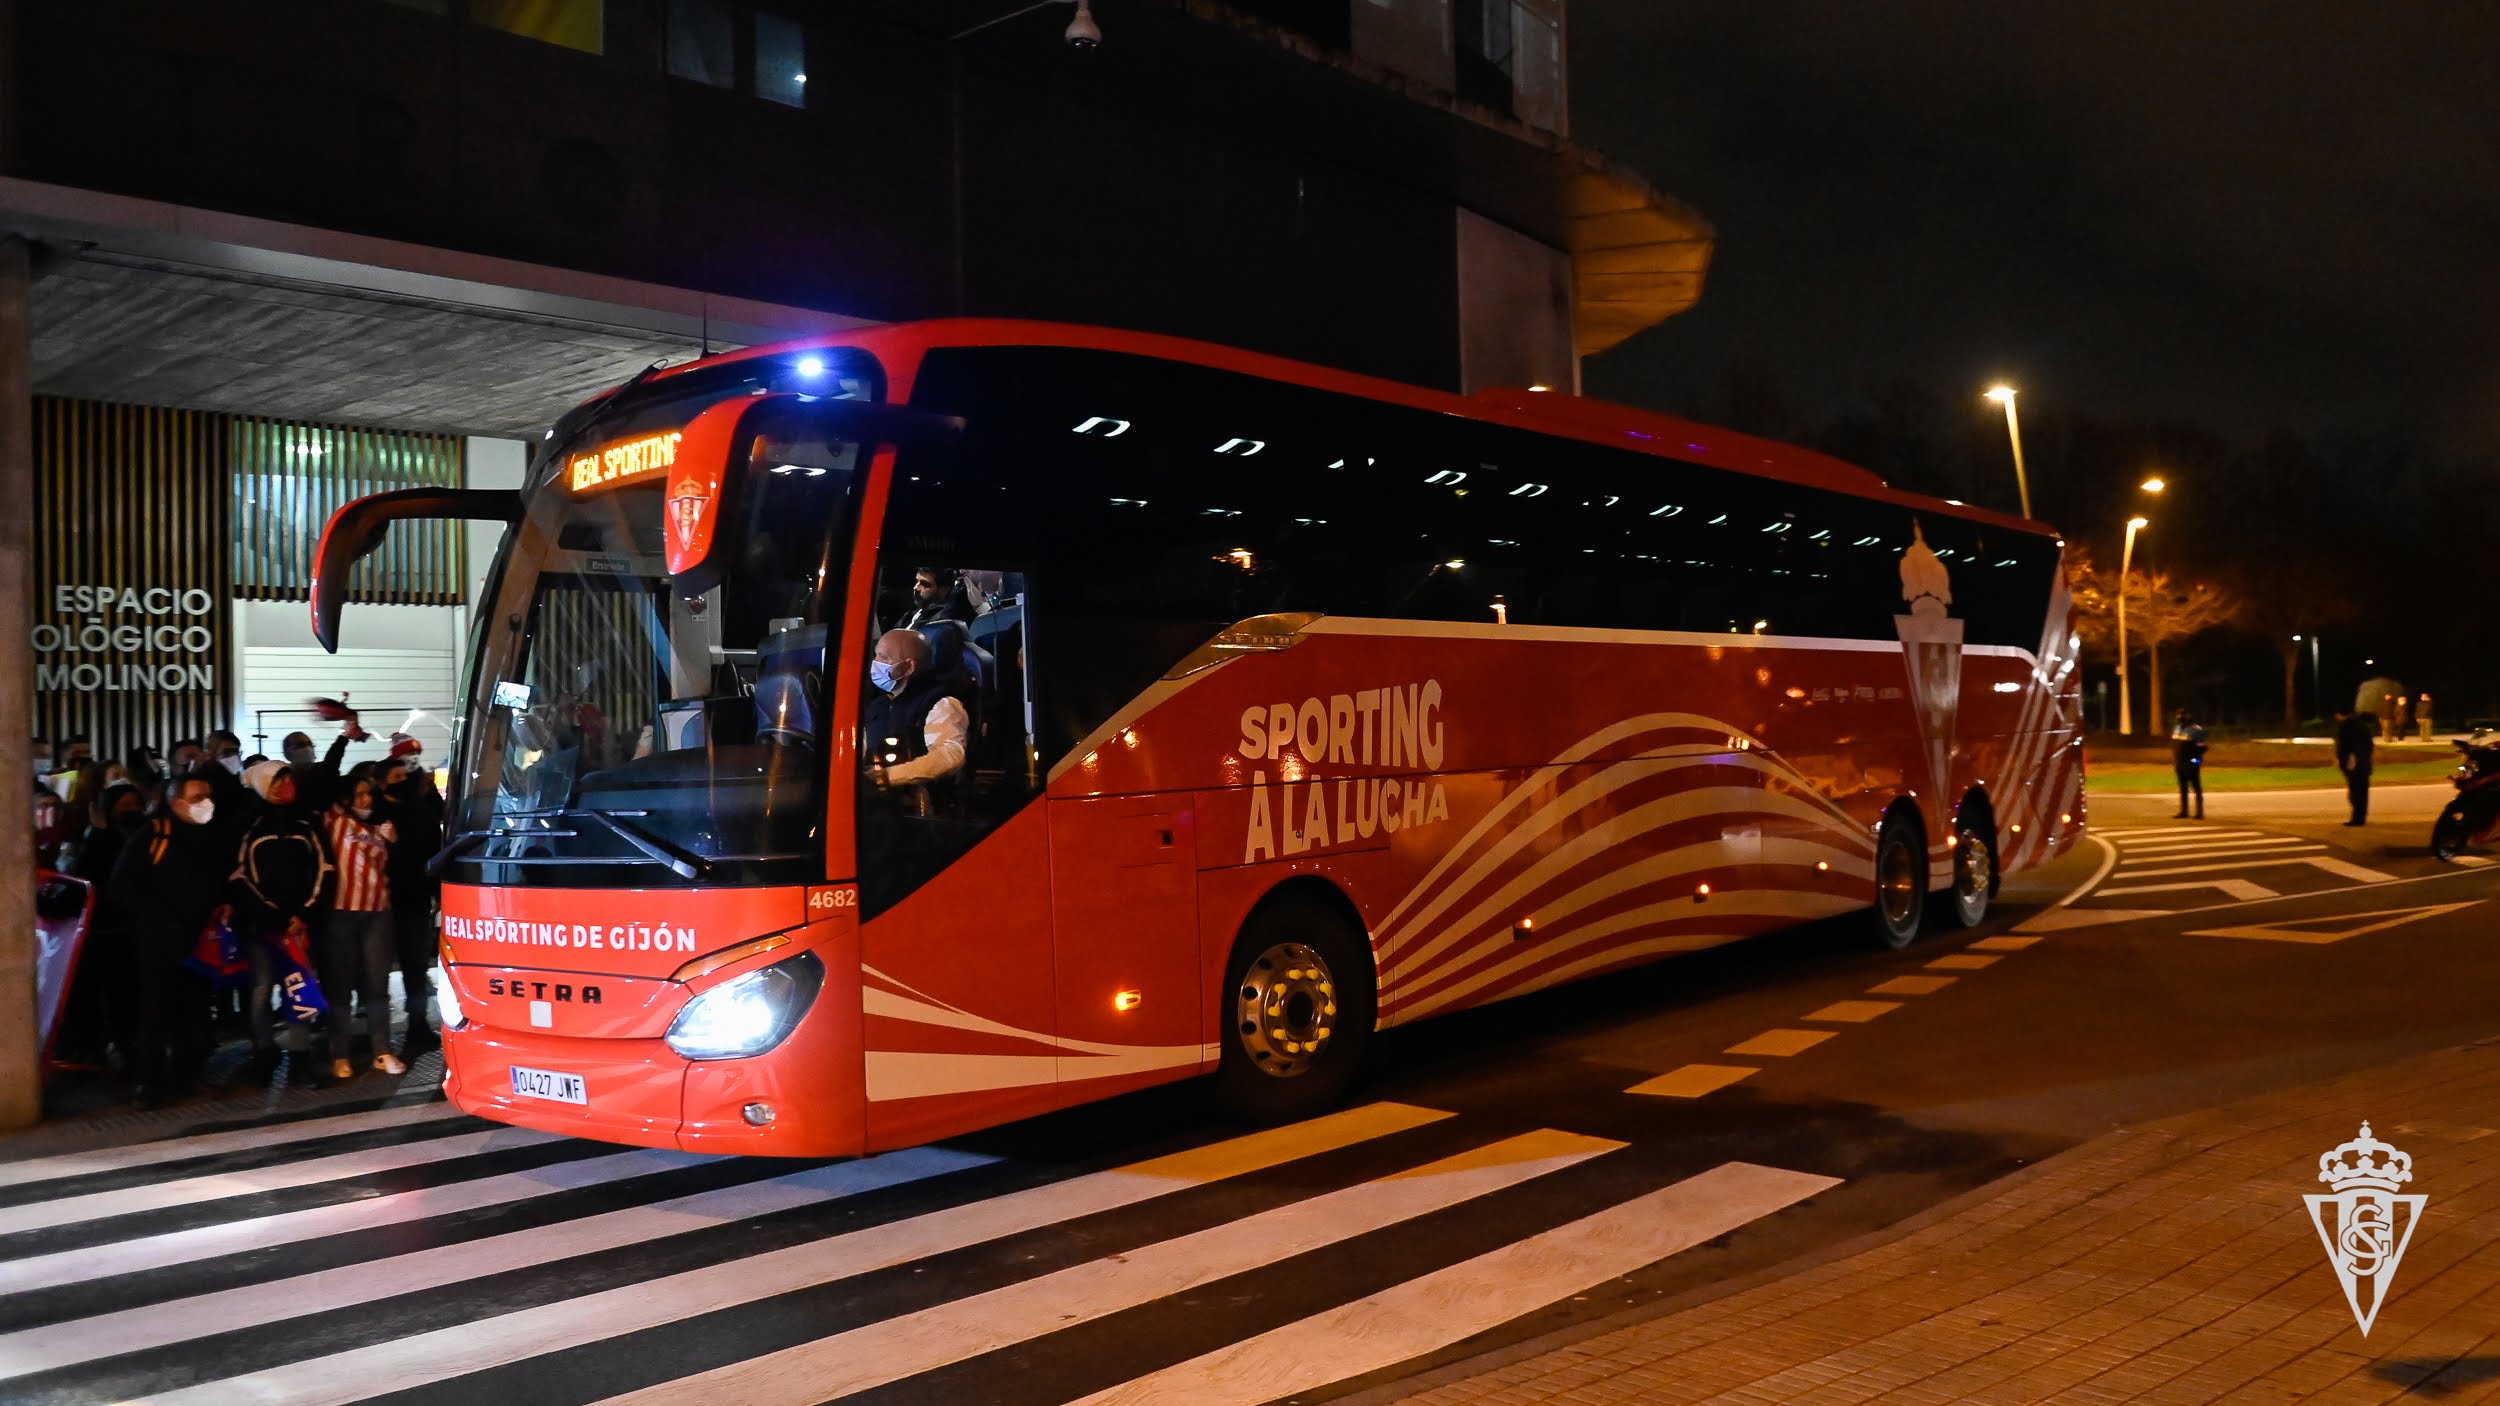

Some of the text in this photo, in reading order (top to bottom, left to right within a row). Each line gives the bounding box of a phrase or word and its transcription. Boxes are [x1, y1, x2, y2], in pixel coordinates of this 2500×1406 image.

[573, 454, 602, 491] REAL
[55, 585, 213, 615] ESPACIO
[36, 663, 213, 691] MOLINON
[1238, 679, 1444, 770] SPORTING
[1244, 770, 1449, 864] A LA LUCHA
[809, 889, 856, 908] 4682
[445, 915, 696, 952] REAL SPORTING DE GIJÓN
[489, 977, 602, 1004] SETRA
[519, 1071, 580, 1099] 0427 JWF
